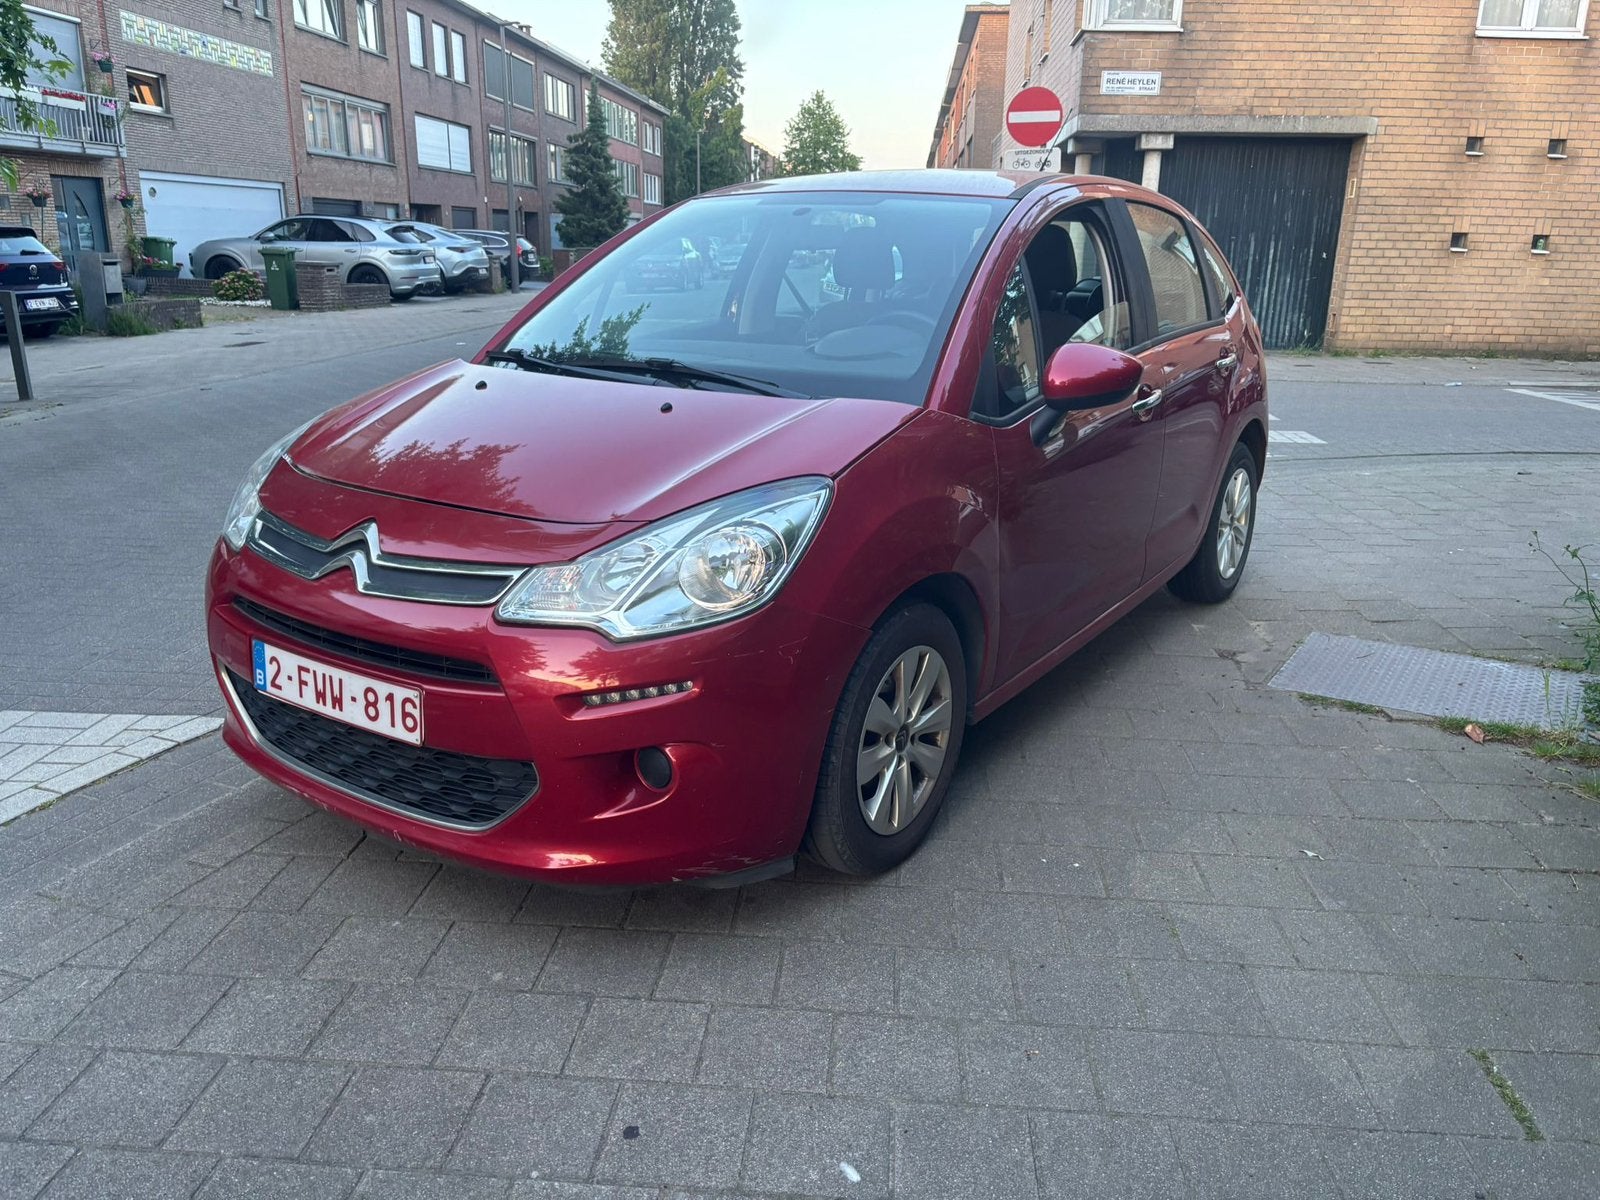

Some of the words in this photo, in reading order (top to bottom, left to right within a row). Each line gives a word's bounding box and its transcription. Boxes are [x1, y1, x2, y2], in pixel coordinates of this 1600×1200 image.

[1106, 77, 1126, 85] RENÉ
[1127, 78, 1157, 86] HEYLEN
[256, 668, 264, 685] B
[268, 655, 418, 734] 2-FWW-816
